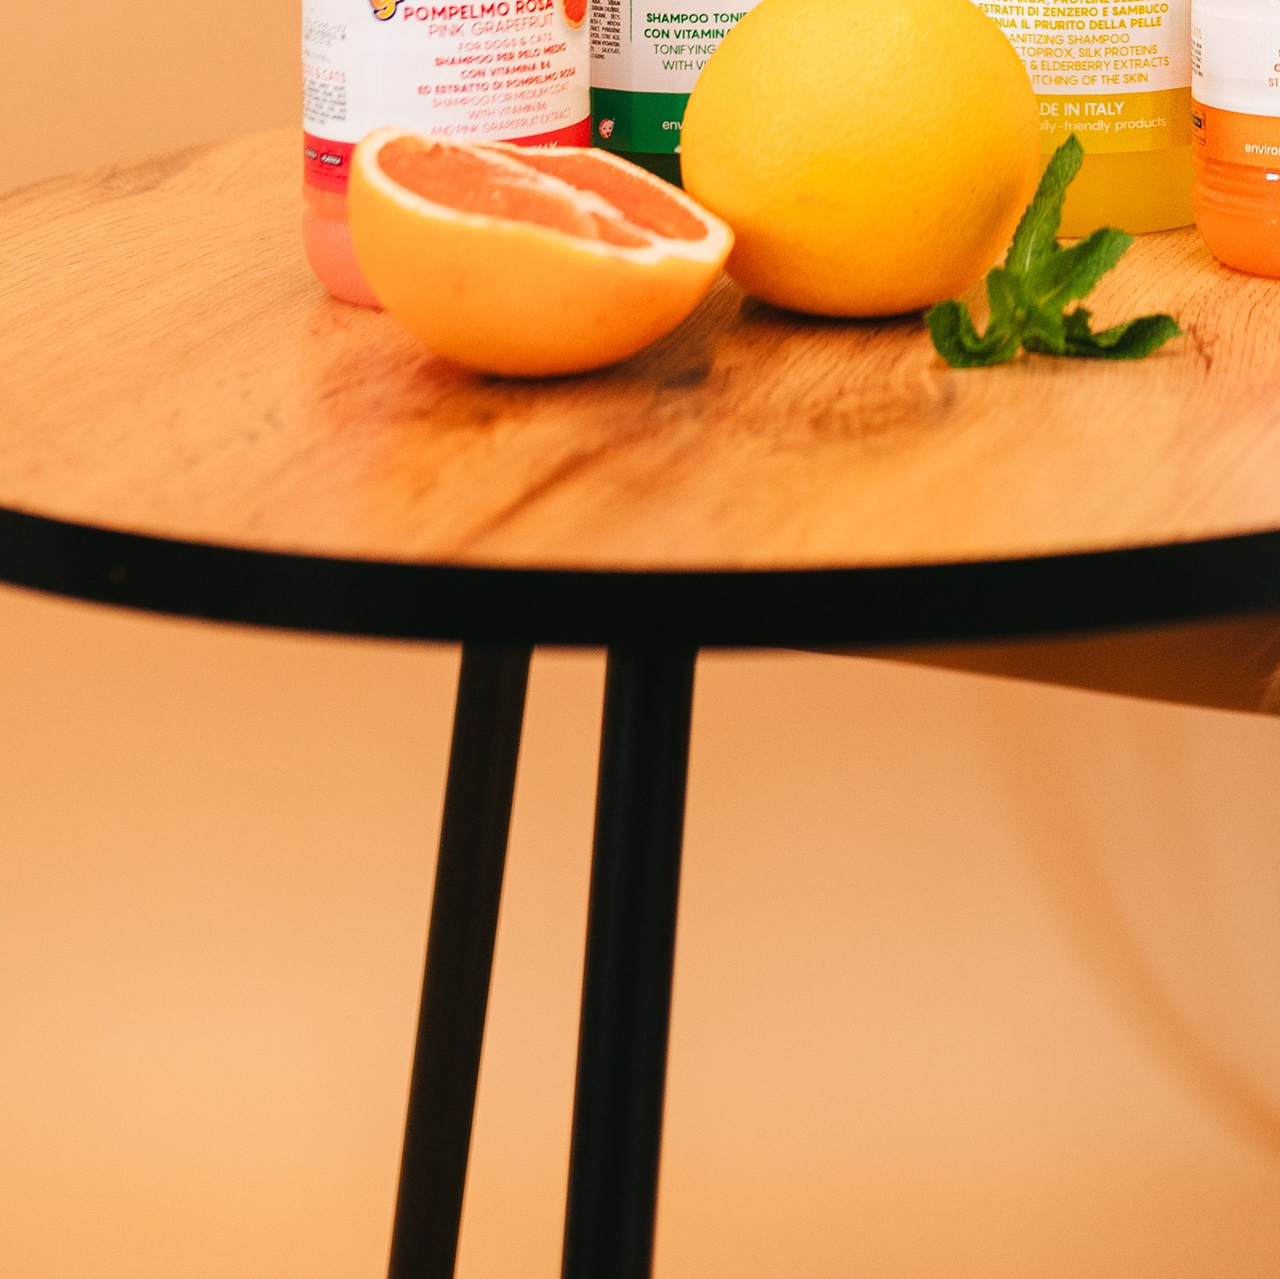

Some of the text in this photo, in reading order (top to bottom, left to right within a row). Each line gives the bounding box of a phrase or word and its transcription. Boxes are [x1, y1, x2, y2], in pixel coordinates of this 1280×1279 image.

[404, 2, 509, 21] POMPELMO
[1028, 6, 1039, 16] DI
[1043, 7, 1098, 17] ZENZERO
[1103, 6, 1108, 16] E
[1113, 3, 1168, 16] SAMBUCO
[646, 13, 709, 23] SHAMPOO
[992, 17, 1161, 30] NUA IL PRURITO DELLA PELLE
[429, 13, 553, 38] PINK GRAPEFRUIT
[644, 29, 670, 38] CON
[1007, 33, 1130, 45] ANITIZING SHAMPOO
[435, 43, 567, 67] SHAMPOO PER PELO MEDIO
[654, 44, 716, 54] TONIFYING
[1015, 45, 1158, 59] TOPIROX, SILK PROTEINS
[461, 68, 485, 78] CON
[490, 63, 536, 77] VITAMINA
[662, 60, 693, 70] WITH
[1030, 60, 1038, 70] &
[1041, 60, 1110, 71] ELDERBERRY
[1114, 57, 1170, 69] EXTRACTS
[417, 85, 432, 95] ED
[435, 81, 489, 94] ESTRATTO
[493, 80, 503, 90] DI
[506, 72, 557, 89] POMPELMO
[1032, 73, 1148, 85] ITCHING OF THE SKIN
[1040, 101, 1125, 116] DE IN ITALY
[1115, 117, 1166, 132] products
